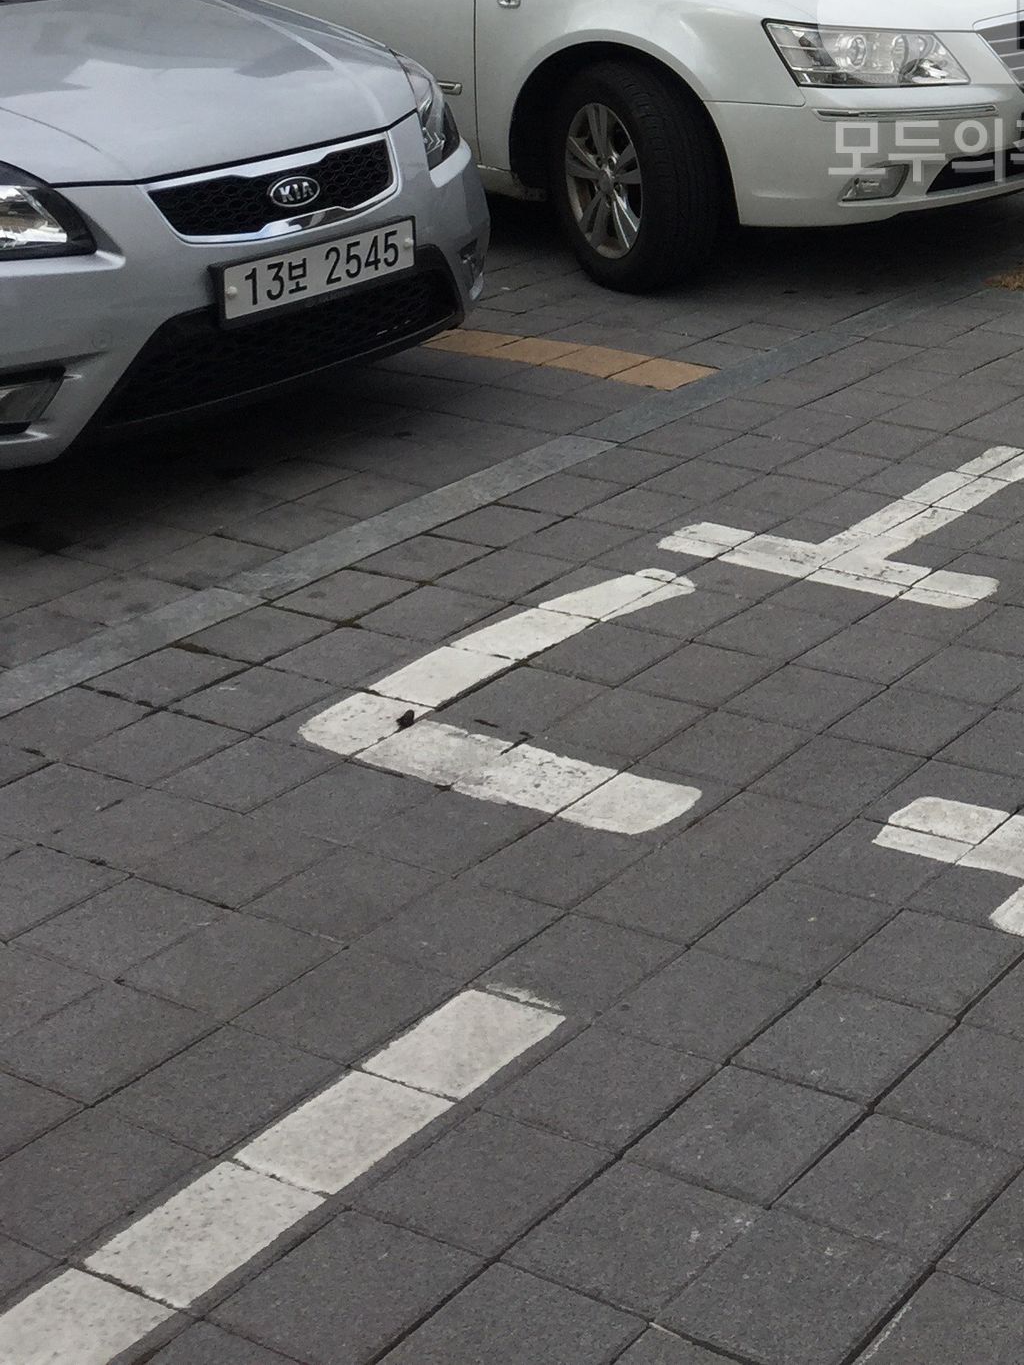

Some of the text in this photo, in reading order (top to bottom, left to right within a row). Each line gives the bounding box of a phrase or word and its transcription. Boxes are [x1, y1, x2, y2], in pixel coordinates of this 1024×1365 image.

[278, 180, 314, 203] KIA
[244, 229, 400, 306] 13보 2545
